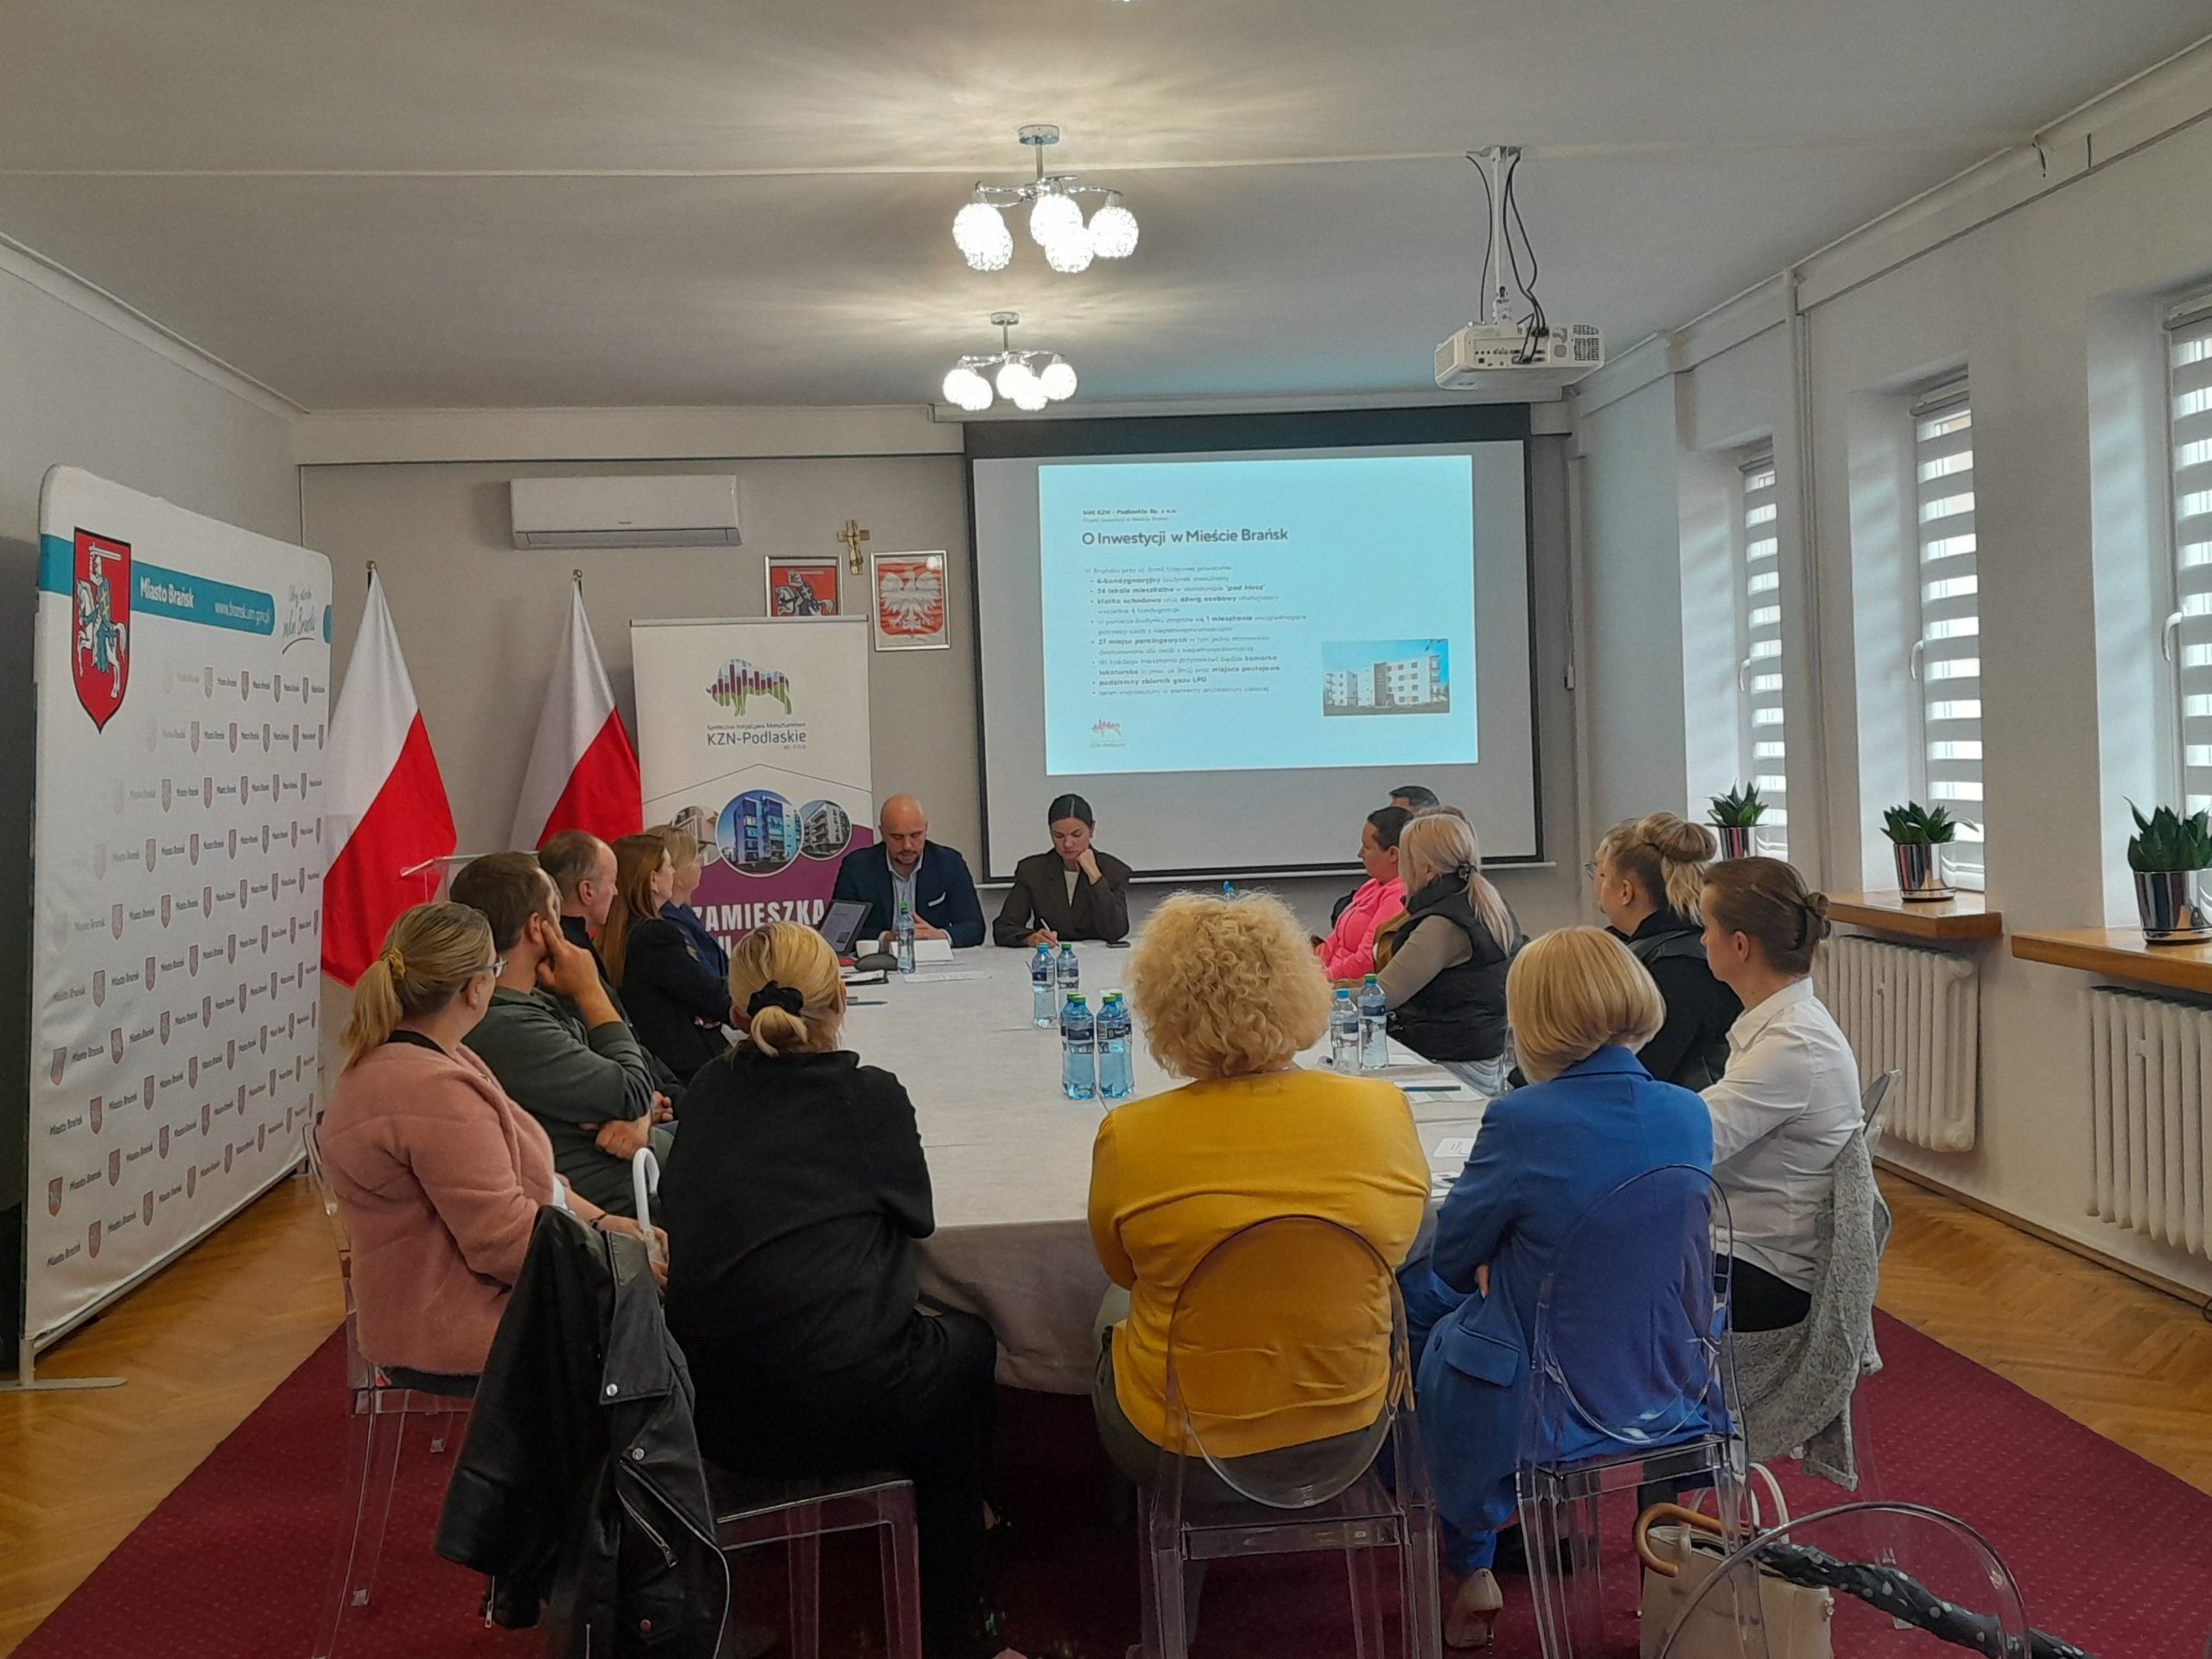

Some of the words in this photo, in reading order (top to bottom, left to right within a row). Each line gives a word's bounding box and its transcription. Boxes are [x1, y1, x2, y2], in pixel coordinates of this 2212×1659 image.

[1082, 532, 1095, 545] O
[1097, 531, 1166, 546] Inwestycji
[1171, 533, 1183, 543] w
[1186, 529, 1238, 543] Mieście
[1242, 528, 1289, 542] Brańsk
[141, 576, 167, 603] Miasto
[168, 583, 194, 608] Brańsk
[708, 730, 807, 747] KZN-Podlaskie
